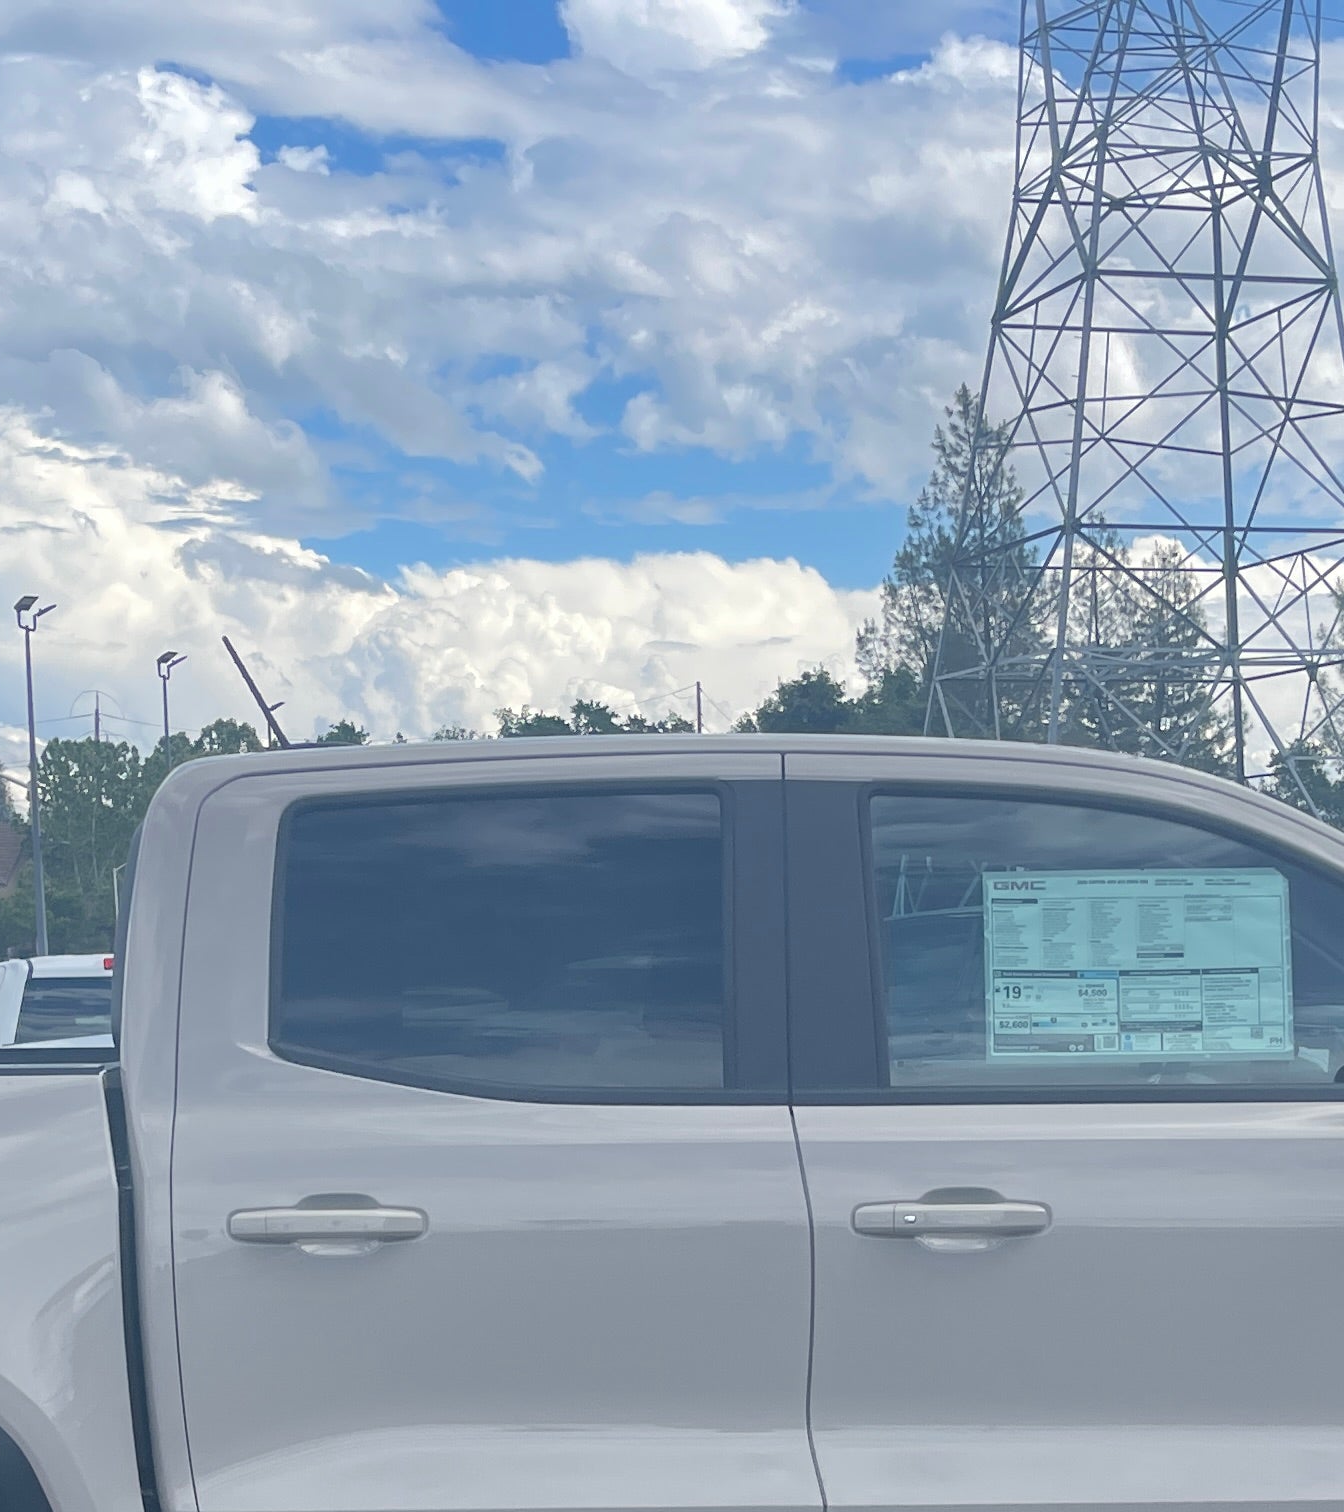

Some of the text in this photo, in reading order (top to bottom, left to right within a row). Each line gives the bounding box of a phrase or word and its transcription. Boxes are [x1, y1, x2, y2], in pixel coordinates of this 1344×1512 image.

[993, 880, 1047, 891] GMC
[1003, 985, 1021, 999] 19
[1078, 988, 1107, 998] $4,500
[999, 1020, 1028, 1029] $2,600
